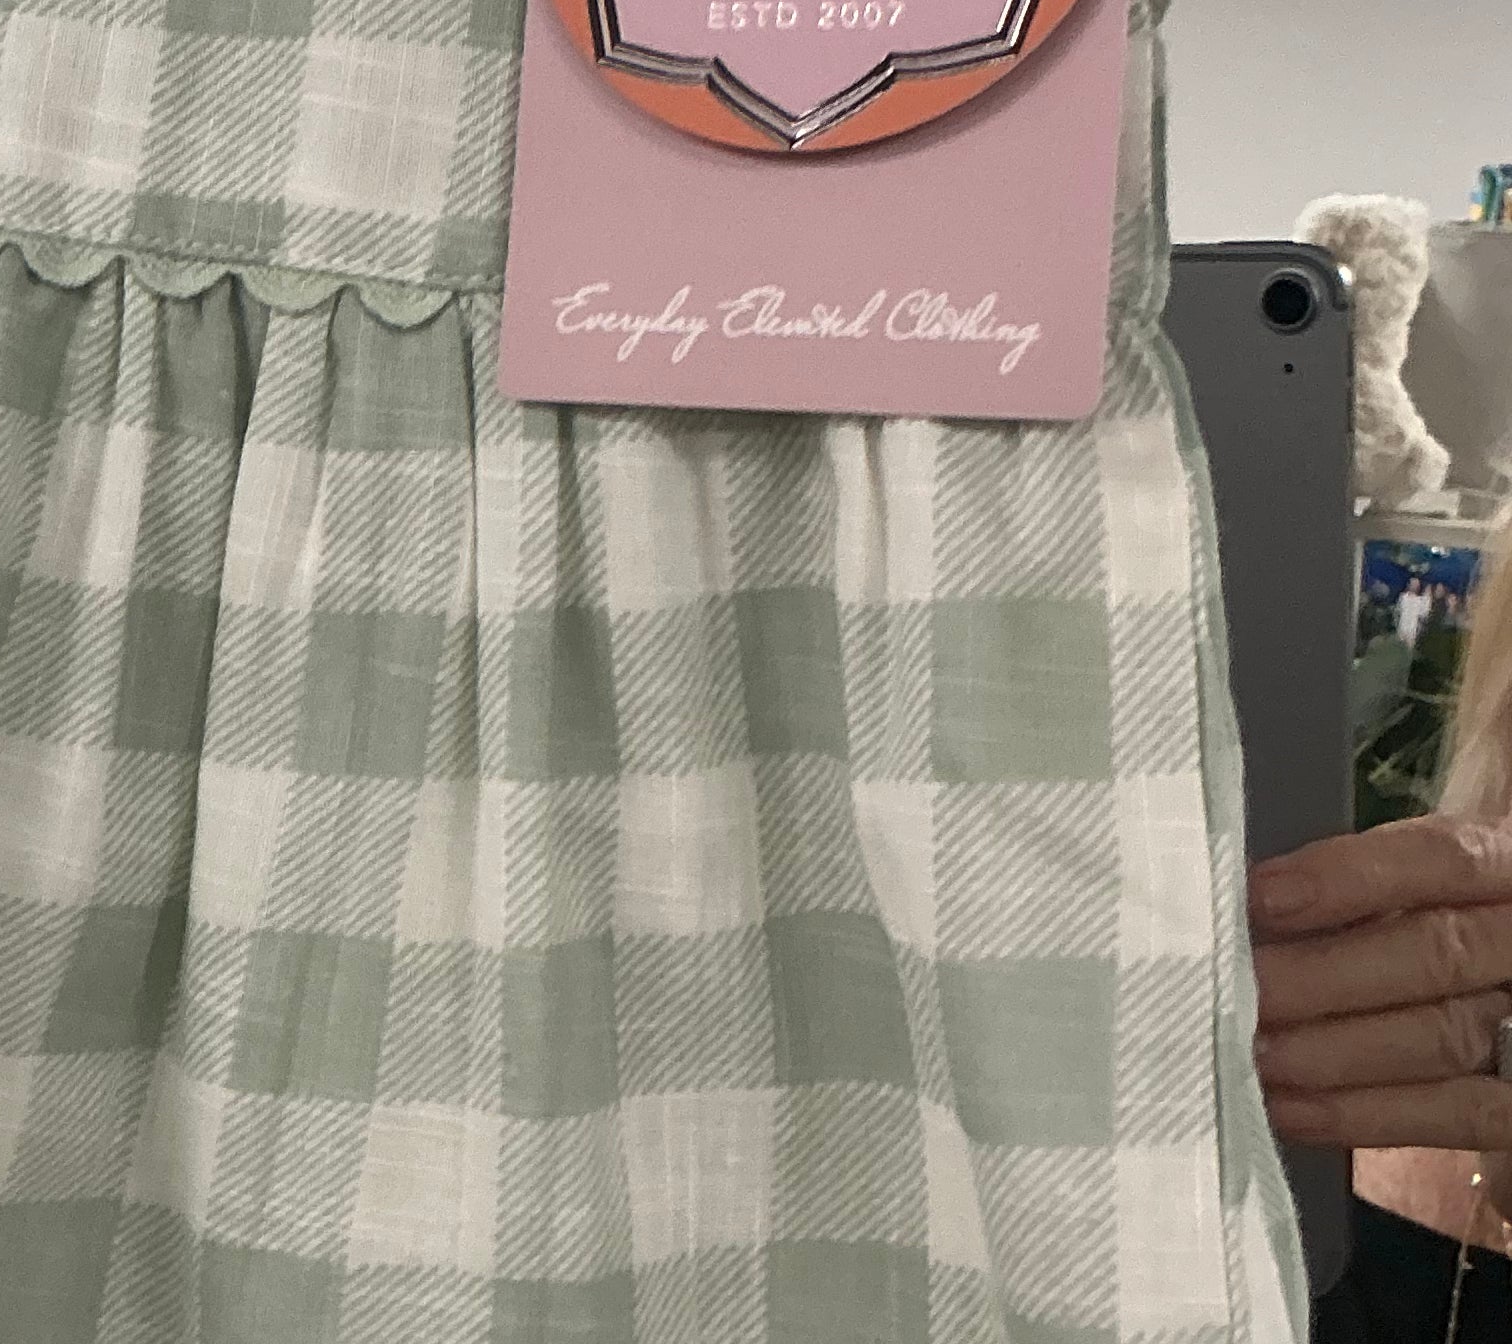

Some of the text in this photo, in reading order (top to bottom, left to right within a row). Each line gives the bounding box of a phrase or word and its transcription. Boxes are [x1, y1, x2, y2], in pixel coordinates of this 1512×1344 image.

[707, 0, 798, 30] ESTD
[552, 282, 709, 363] Everyday
[886, 287, 1044, 375] Clothing
